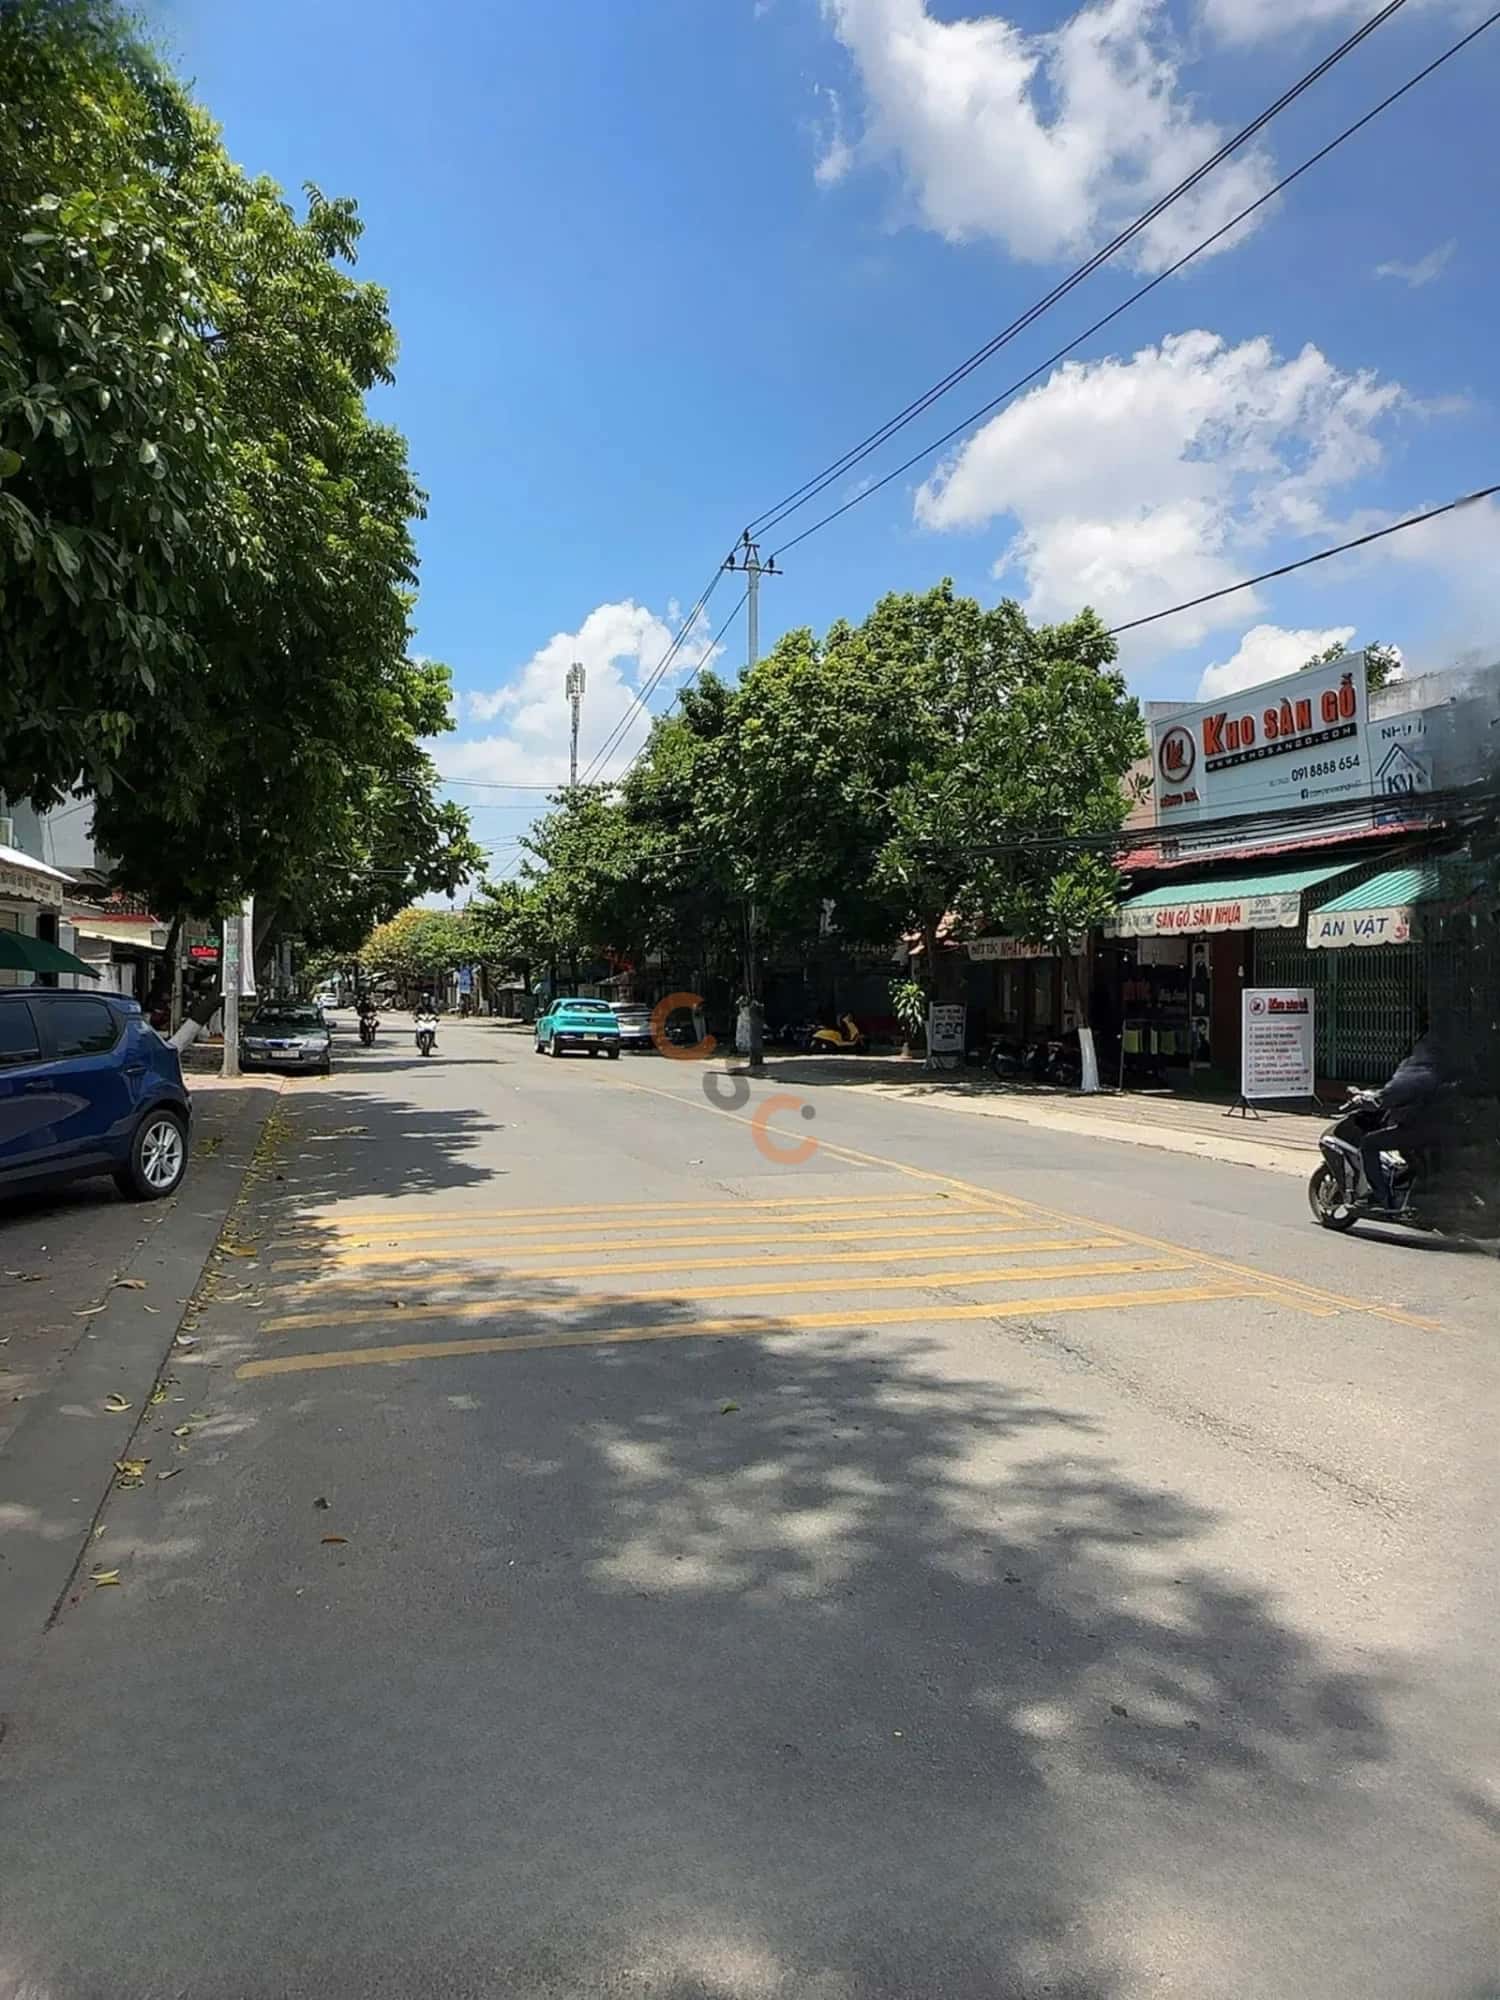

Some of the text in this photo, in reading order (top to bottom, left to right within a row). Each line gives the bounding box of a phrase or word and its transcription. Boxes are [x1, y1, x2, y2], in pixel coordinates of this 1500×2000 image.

[1202, 673, 1357, 756] KHO SÀN GỖ
[1338, 754, 1360, 770] 654
[1353, 915, 1389, 938] VẶT
